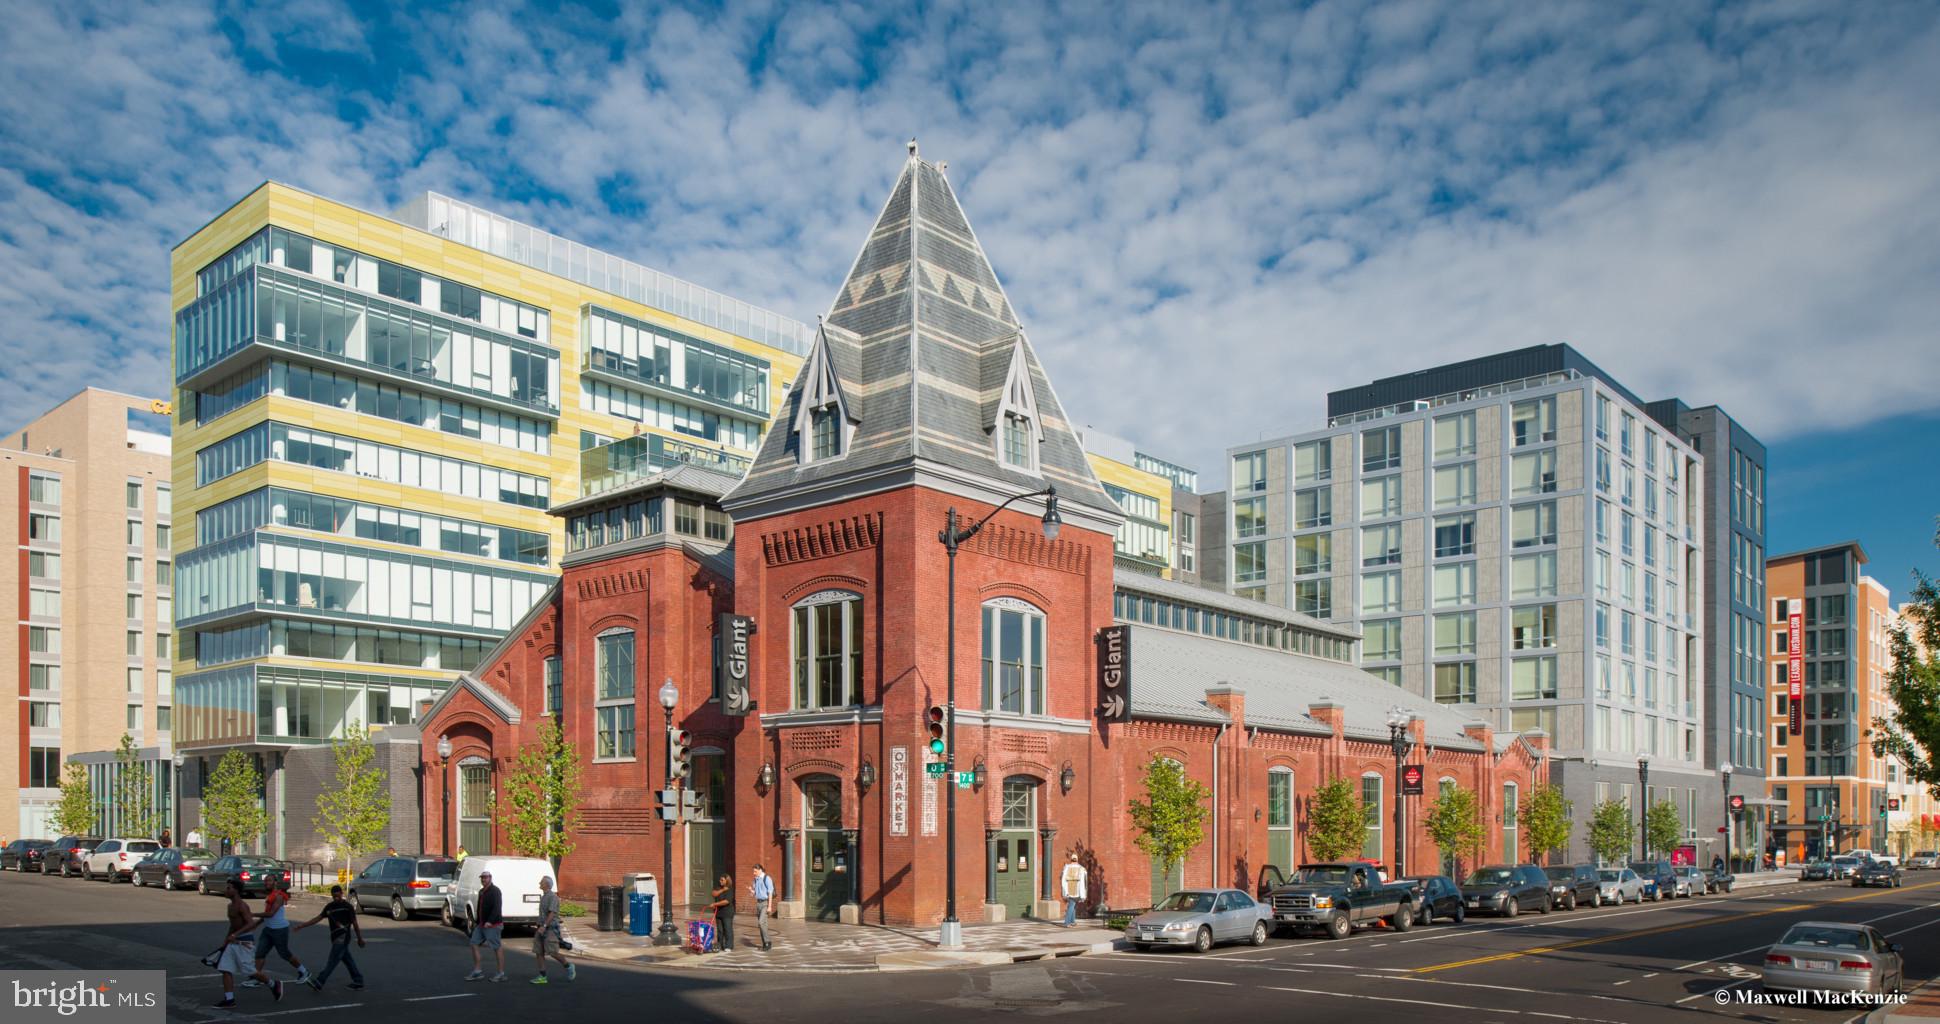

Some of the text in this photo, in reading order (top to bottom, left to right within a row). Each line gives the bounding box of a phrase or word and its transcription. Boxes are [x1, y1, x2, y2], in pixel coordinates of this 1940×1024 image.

[729, 619, 747, 679] Giant
[1104, 630, 1122, 688] Giant
[894, 773, 904, 832] MARKET
[961, 773, 967, 782] 7
